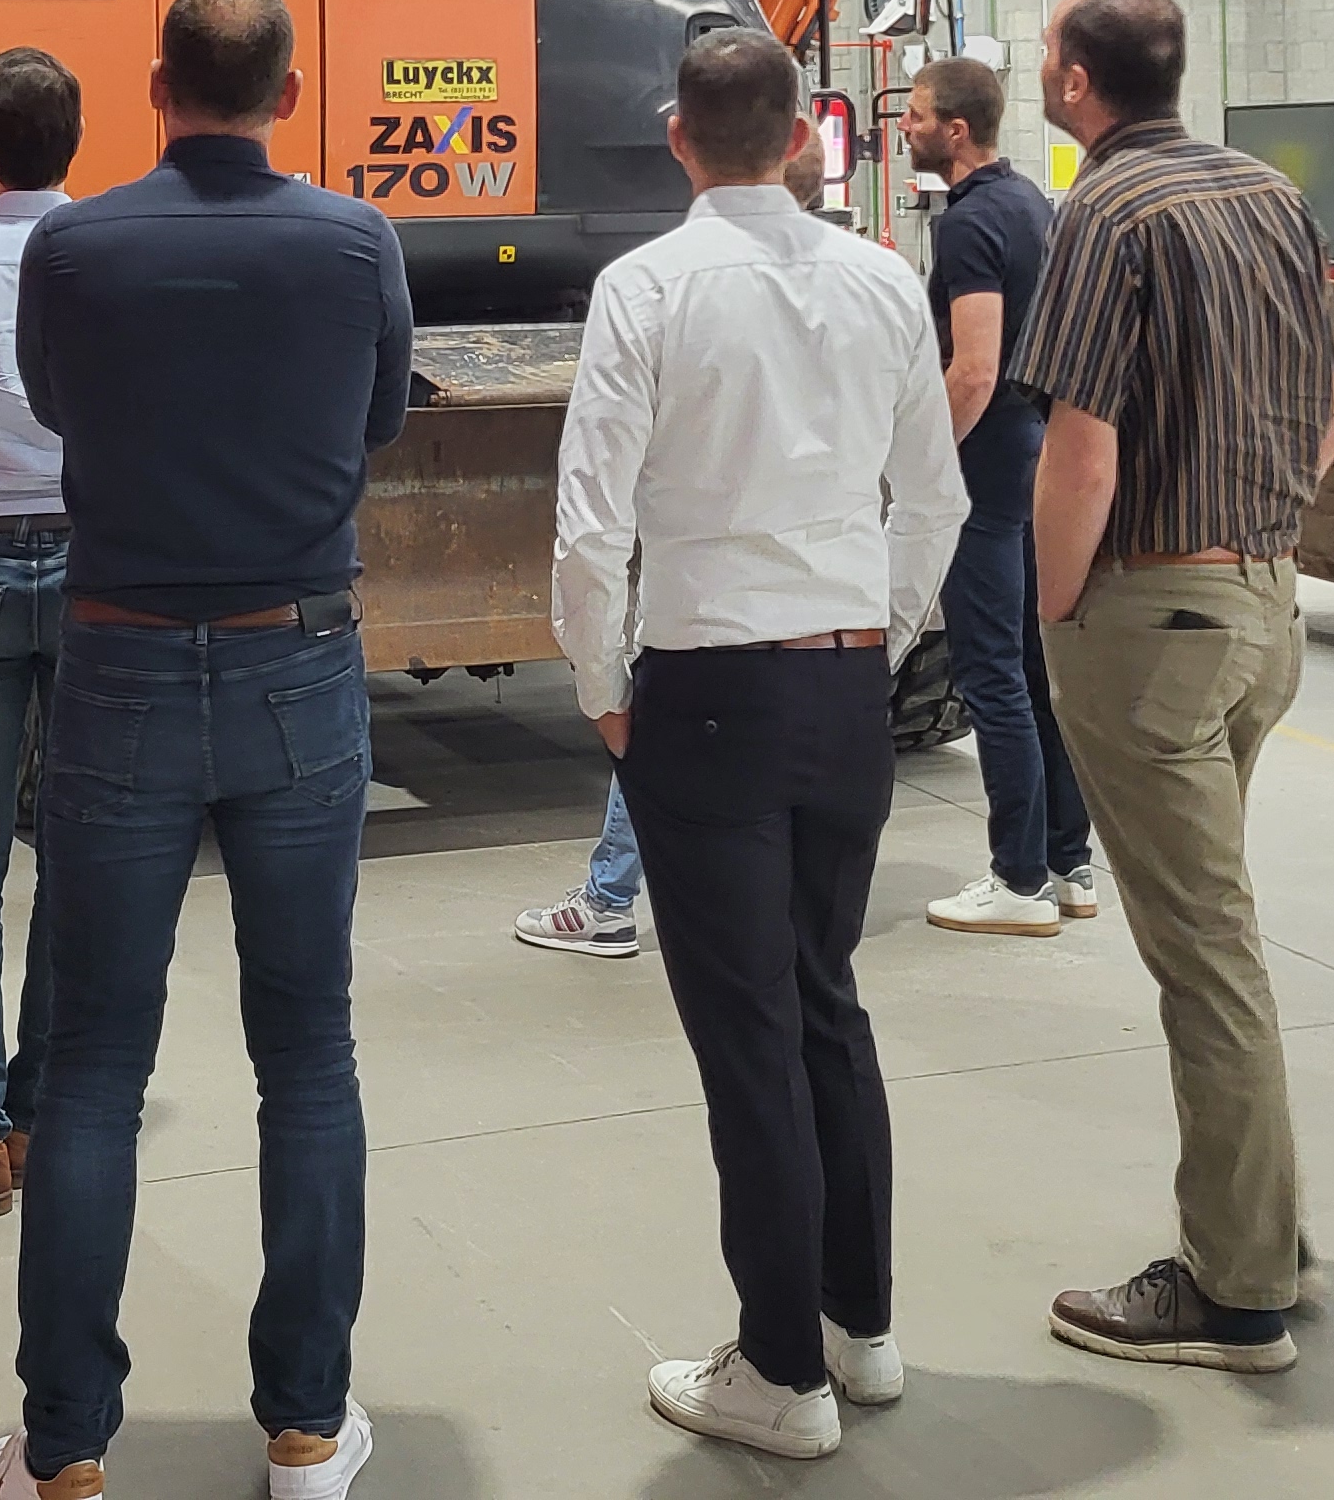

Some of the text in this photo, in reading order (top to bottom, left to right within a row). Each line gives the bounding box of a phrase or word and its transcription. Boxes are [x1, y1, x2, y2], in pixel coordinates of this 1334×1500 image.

[386, 61, 494, 90] Luyckx
[386, 90, 423, 99] BRECHT
[369, 106, 517, 154] ZAXIS
